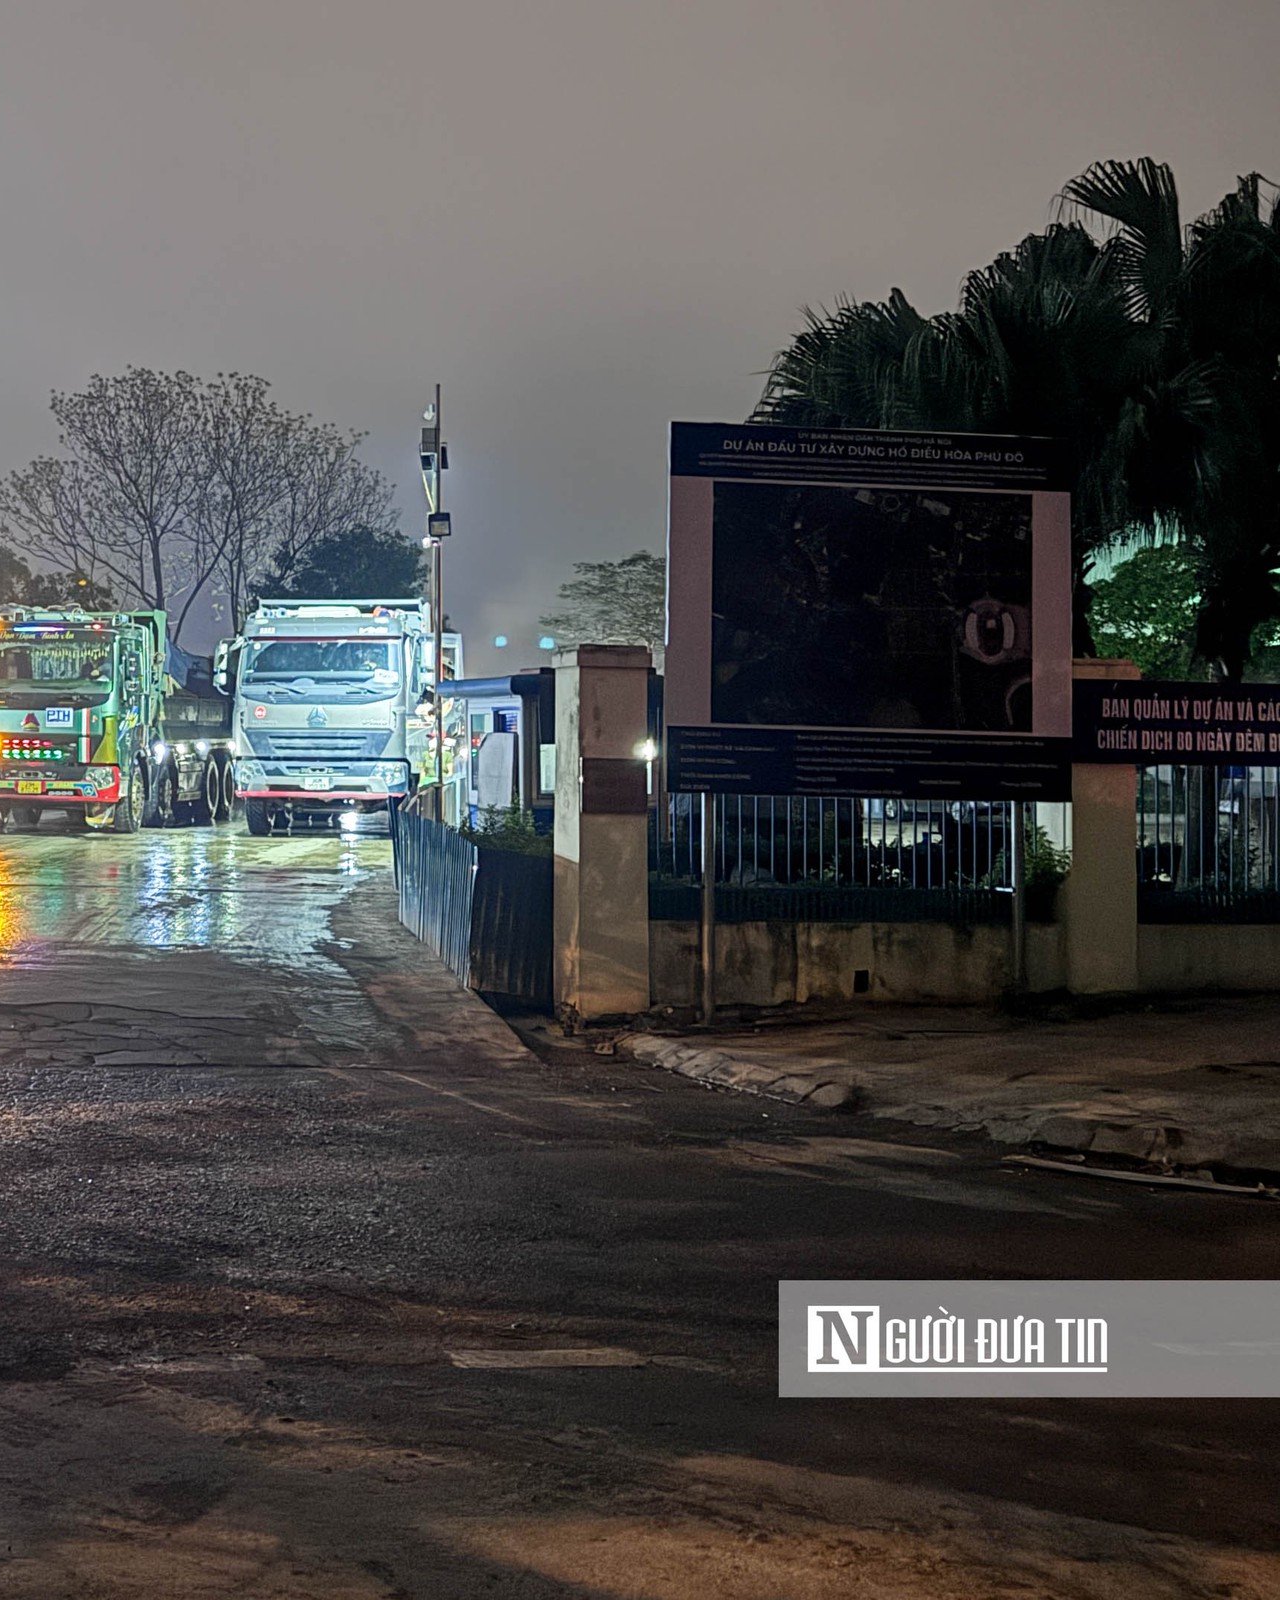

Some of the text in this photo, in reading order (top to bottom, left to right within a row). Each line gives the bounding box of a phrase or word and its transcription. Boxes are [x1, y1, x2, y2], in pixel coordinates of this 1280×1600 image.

[745, 439, 764, 452] ÁN
[799, 442, 817, 454] TƯ
[1102, 698, 1129, 718] BAN
[1133, 692, 1170, 721] QUẢN
[1174, 696, 1189, 720] LÝ
[1193, 698, 1212, 724] DỰ
[1214, 696, 1233, 721] ÁN
[1236, 697, 1254, 721] VÀ
[1097, 724, 1137, 750] CHIẾN
[1141, 730, 1172, 755] DỊCH
[1176, 731, 1193, 751] 80
[1196, 727, 1232, 752] NGÀY
[1235, 728, 1265, 752] ĐÊM
